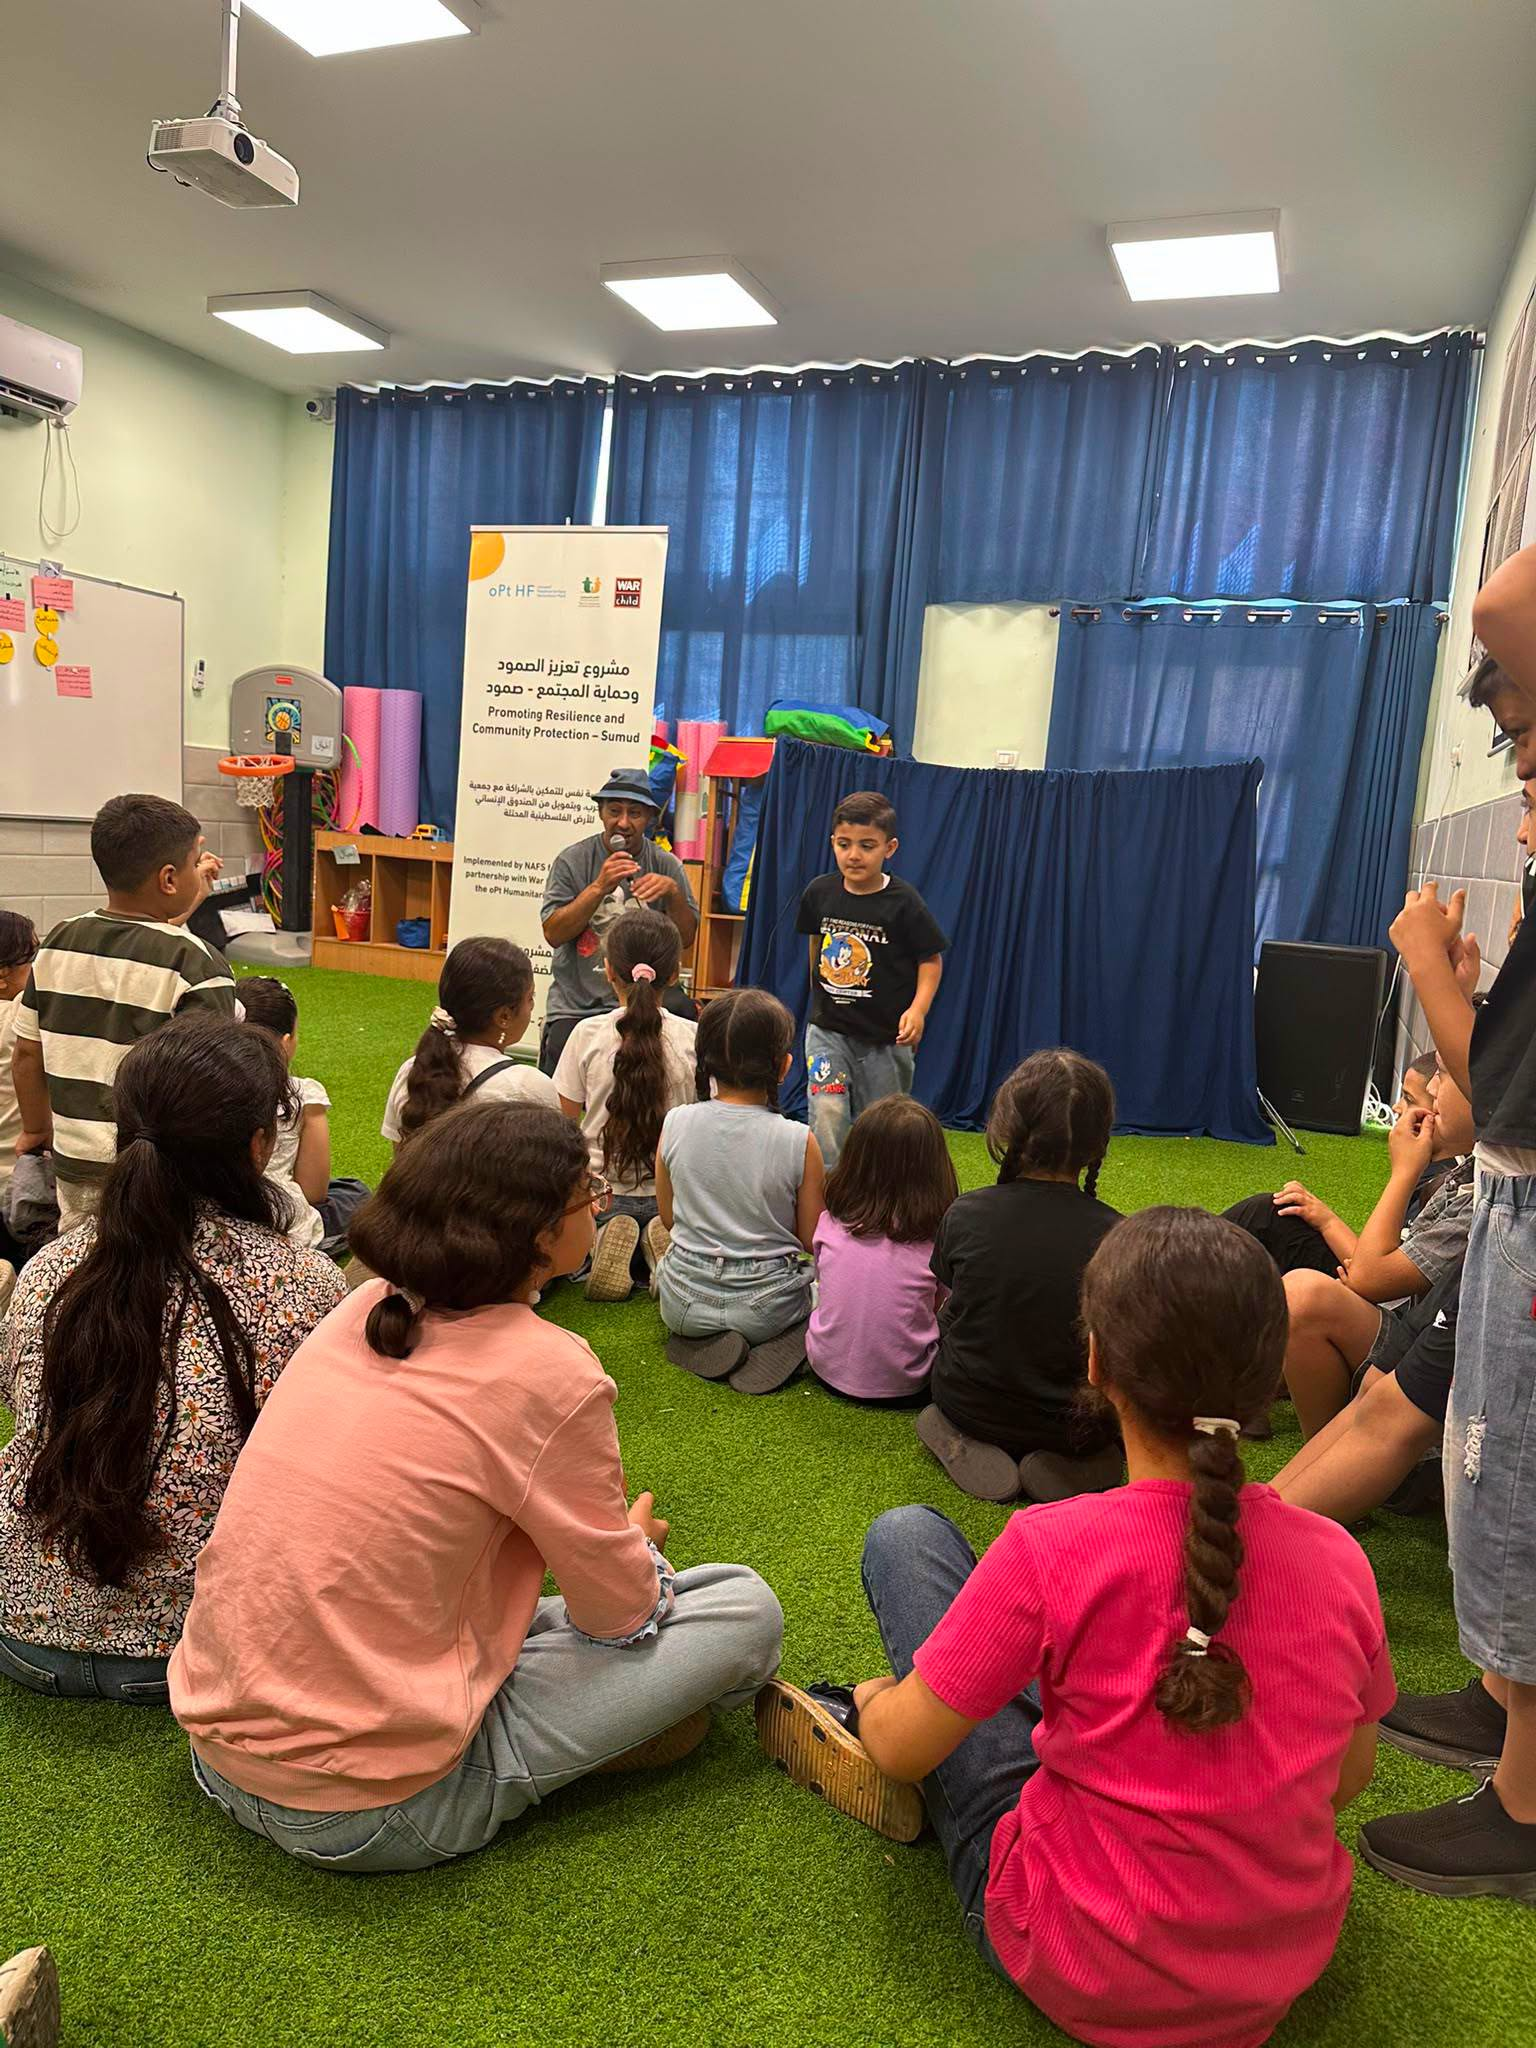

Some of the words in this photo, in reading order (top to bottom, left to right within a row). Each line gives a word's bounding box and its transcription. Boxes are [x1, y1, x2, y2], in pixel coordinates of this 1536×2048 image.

[515, 584, 535, 597] HF
[617, 580, 640, 591] WAR
[616, 595, 638, 606] child
[498, 659, 544, 674] الصمود
[548, 660, 580, 677] تعزيز
[583, 659, 630, 678] مشروع
[486, 684, 524, 697] صمود
[536, 683, 590, 700] المجتمع
[593, 684, 639, 704] وحماية
[488, 706, 542, 722] Promoting
[545, 709, 601, 723] Resilience
[604, 713, 625, 724] and
[472, 723, 531, 739] Community
[533, 726, 589, 740] Protection
[601, 730, 640, 743] Sumud
[469, 780, 491, 790] جمعية
[492, 784, 504, 792] مع
[505, 783, 534, 794] بالشراكة
[535, 786, 564, 796] للتمكين
[565, 788, 584, 798] نفس
[475, 794, 506, 804] الإنساني
[507, 797, 537, 807] الصندوق
[538, 800, 550, 808] من
[503, 808, 529, 818] المحتلة
[530, 812, 572, 822] الفلسطينية
[463, 856, 512, 868] Implemented
[514, 861, 523, 870] by
[524, 862, 546, 871] NAFS
[465, 871, 510, 881] partnership
[511, 875, 527, 883] with
[528, 875, 544, 884] War
[503, 888, 545, 898] Humanitar
